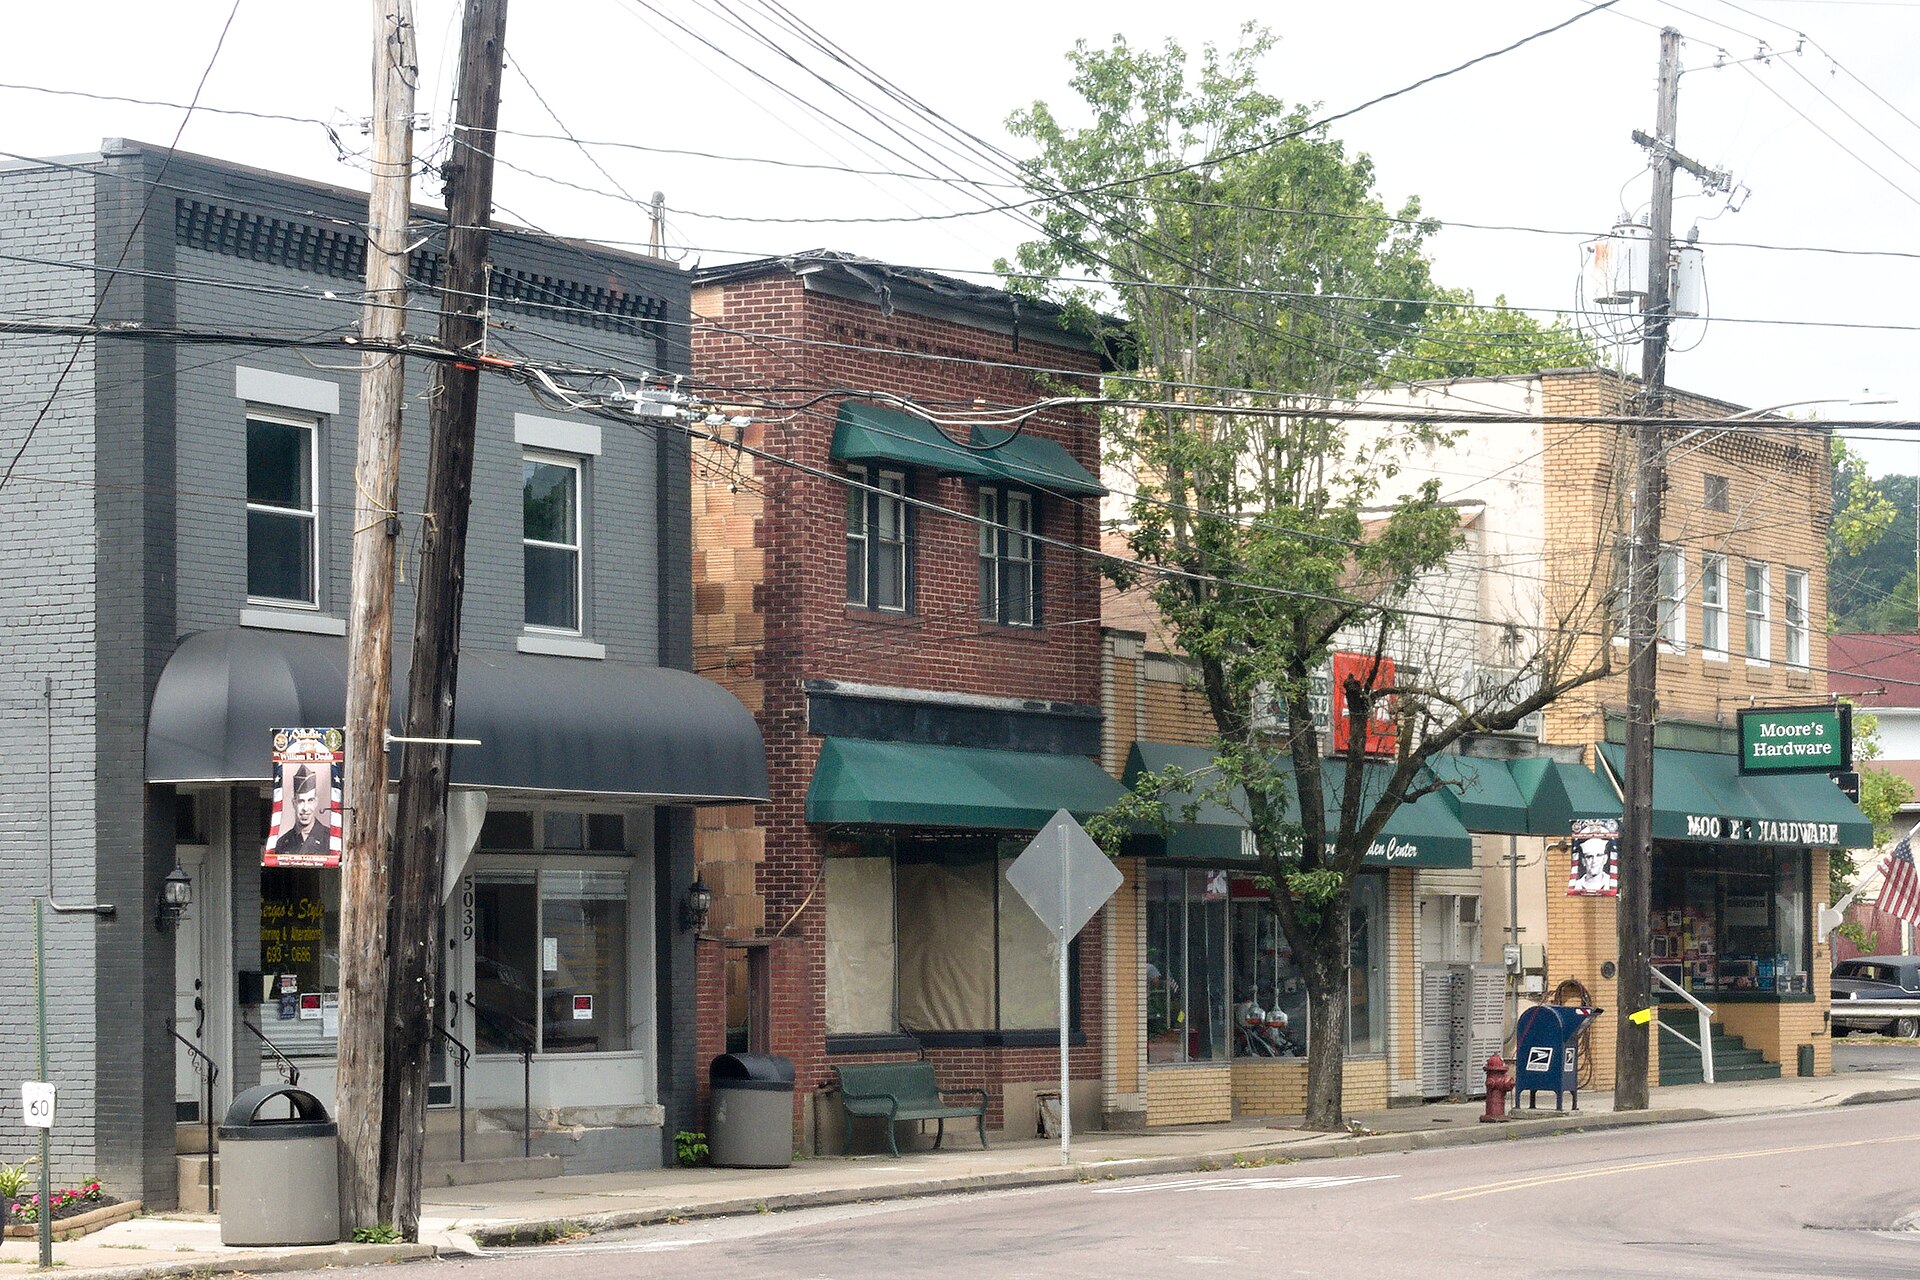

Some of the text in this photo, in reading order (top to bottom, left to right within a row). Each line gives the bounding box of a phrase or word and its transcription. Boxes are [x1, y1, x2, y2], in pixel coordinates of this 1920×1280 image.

[1760, 722, 1824, 737] Moore's
[1753, 742, 1832, 757] Hardware
[1687, 815, 1839, 845] MOOE' HARDWARE
[1366, 837, 1418, 860] den Center
[463, 874, 474, 942] 5039
[266, 946, 281, 963] 693
[292, 946, 311, 962] 0686
[30, 1100, 49, 1117] 60
